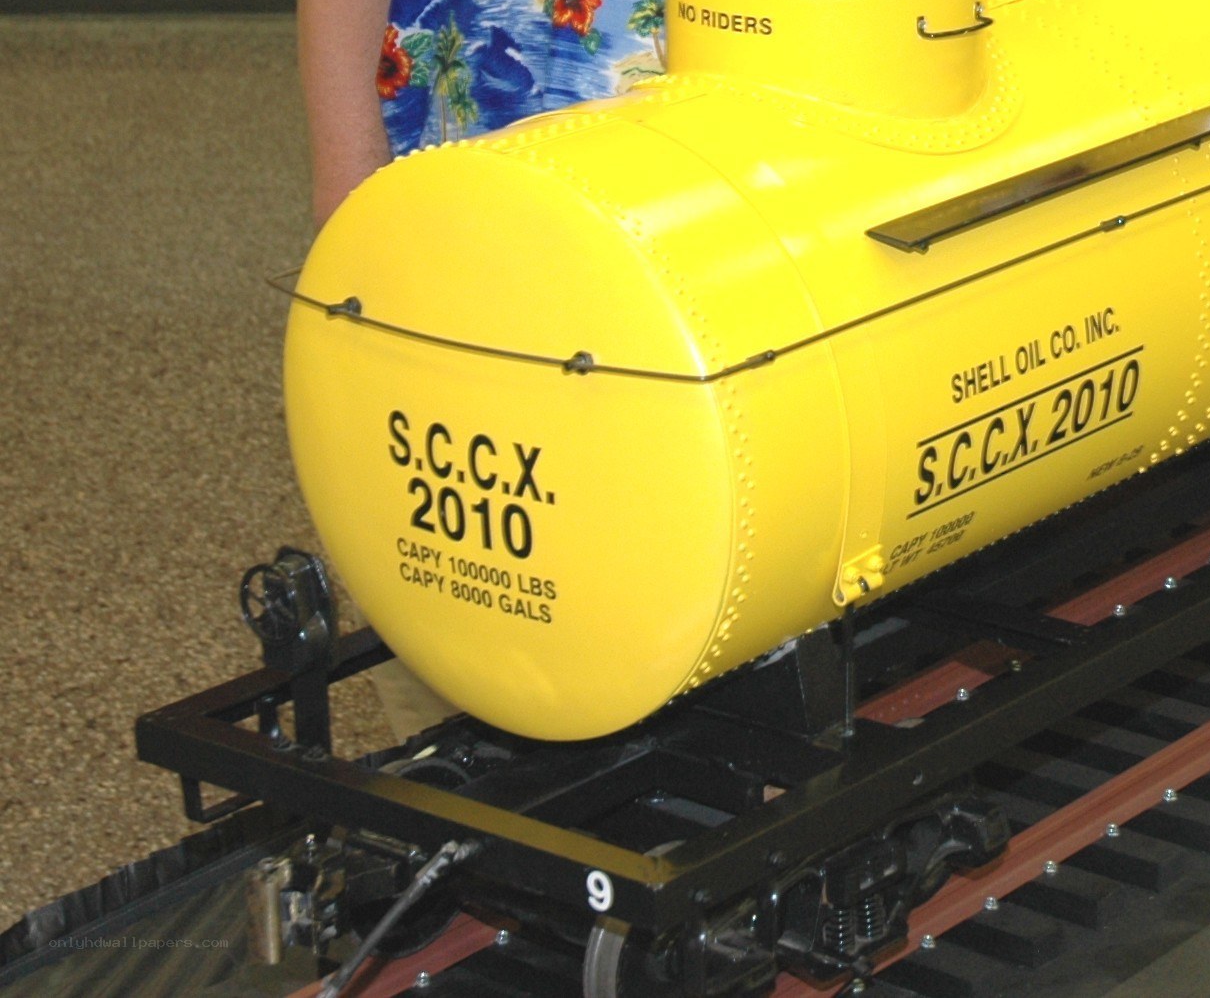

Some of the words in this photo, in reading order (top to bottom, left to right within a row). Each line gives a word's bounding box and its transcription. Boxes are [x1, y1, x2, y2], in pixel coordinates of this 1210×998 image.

[678, 1, 696, 23] NO
[701, 8, 773, 35] RIDERS
[950, 353, 1011, 404] SHELL
[1015, 338, 1047, 375] OIL
[1049, 324, 1081, 359] CO.
[1085, 306, 1120, 345] INC.
[387, 409, 556, 506] S.C.C.X.
[913, 401, 1040, 506] S.C.C.X.
[1044, 358, 1141, 448] 2010
[407, 476, 533, 560] 2010
[890, 531, 929, 561] CAPY
[396, 537, 442, 568] CAPY
[448, 555, 512, 590] 100000
[516, 573, 557, 600] LBS
[399, 561, 445, 593] CAPY
[450, 579, 493, 609] 8000
[498, 593, 552, 624] GALS
[586, 870, 614, 912] 9
